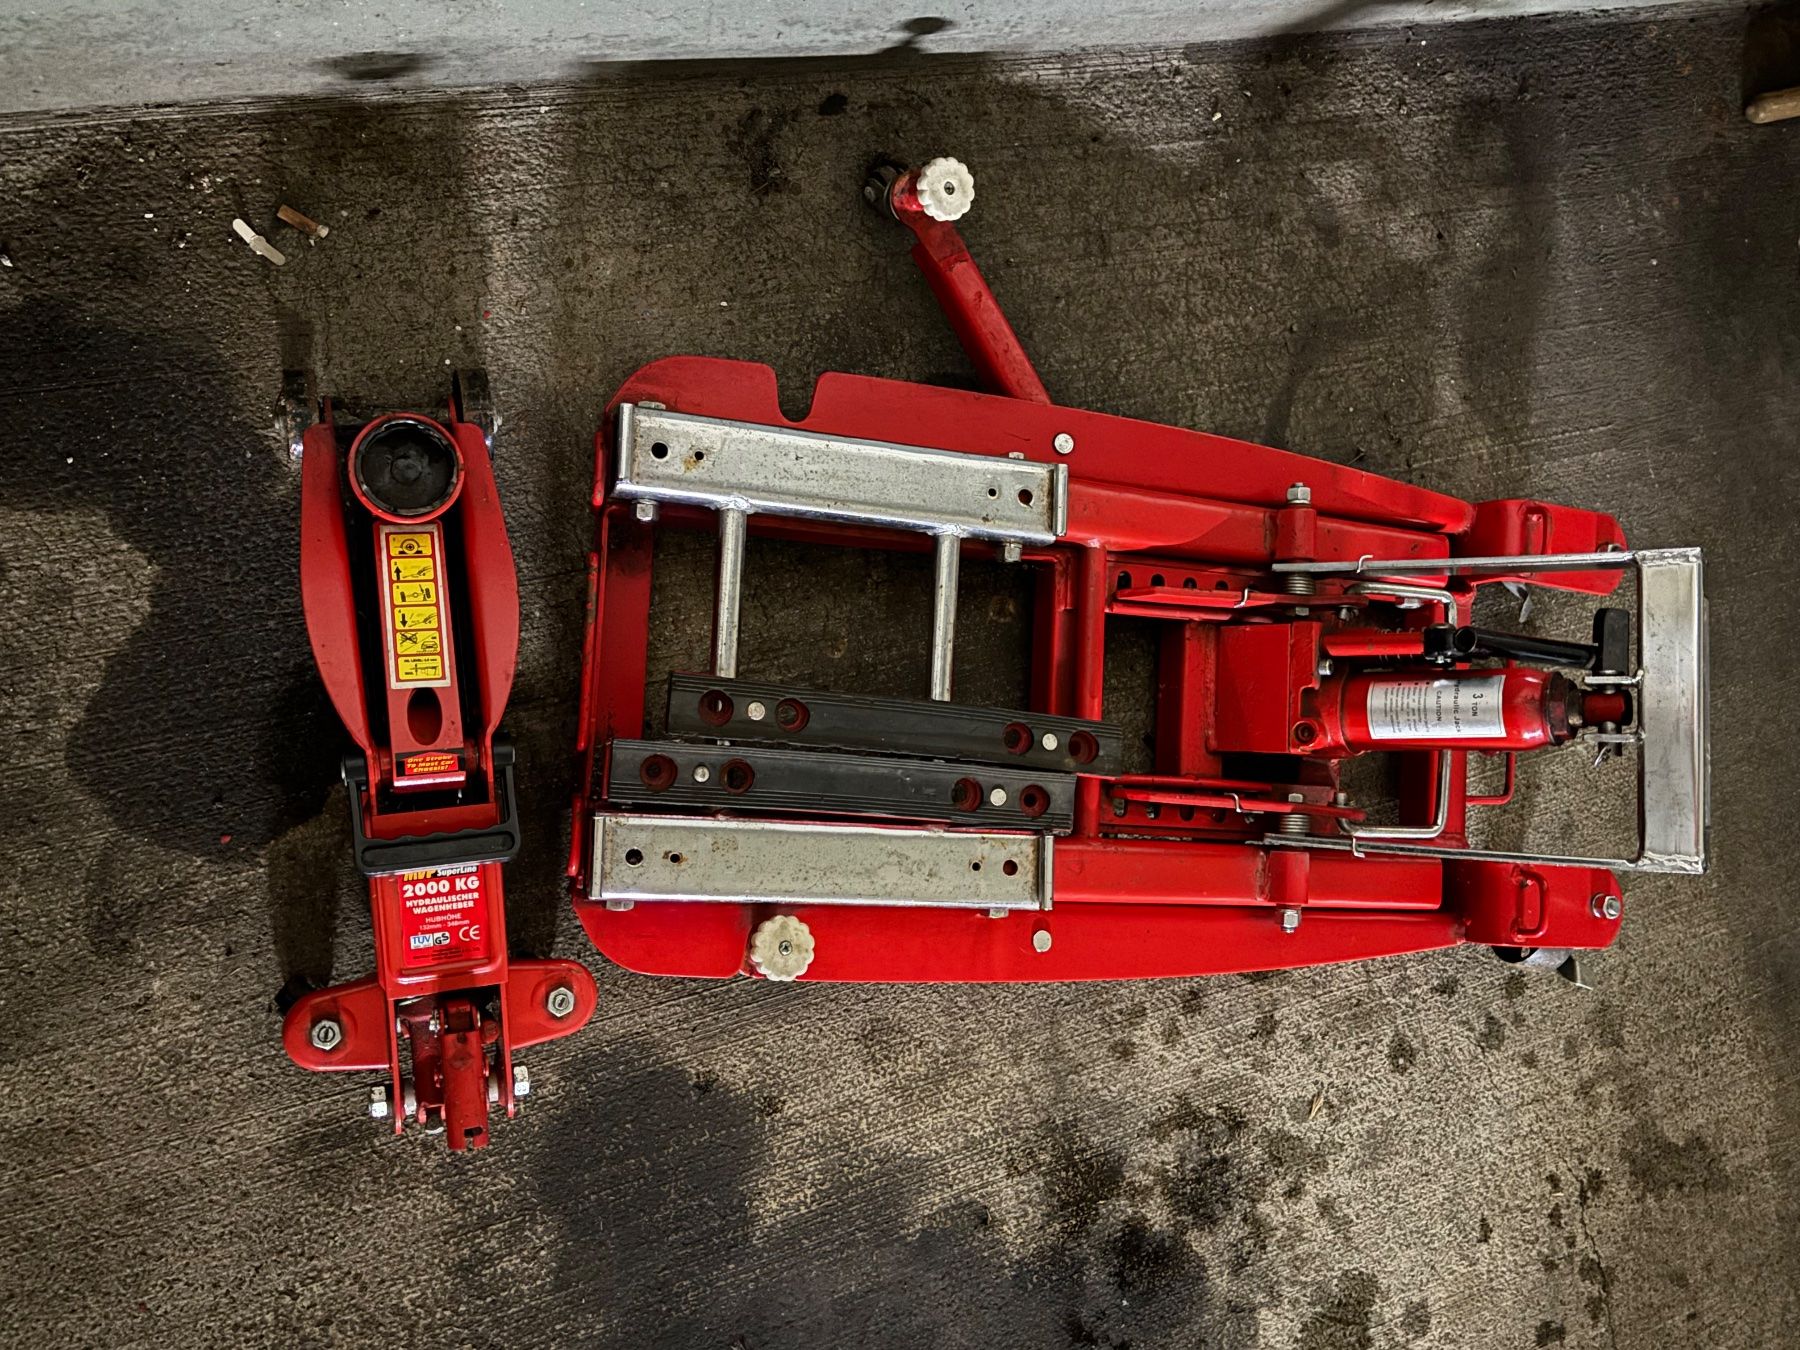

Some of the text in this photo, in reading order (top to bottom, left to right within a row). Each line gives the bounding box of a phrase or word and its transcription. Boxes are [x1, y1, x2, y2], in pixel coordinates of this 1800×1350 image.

[1453, 715, 1461, 733] Jack
[403, 875, 480, 897] 2000 KG
[405, 892, 480, 908] HYDRAULISCHER
[412, 900, 474, 915] WAGENHEBER
[425, 912, 462, 924] HUBHÖHE
[434, 932, 449, 945] GS
